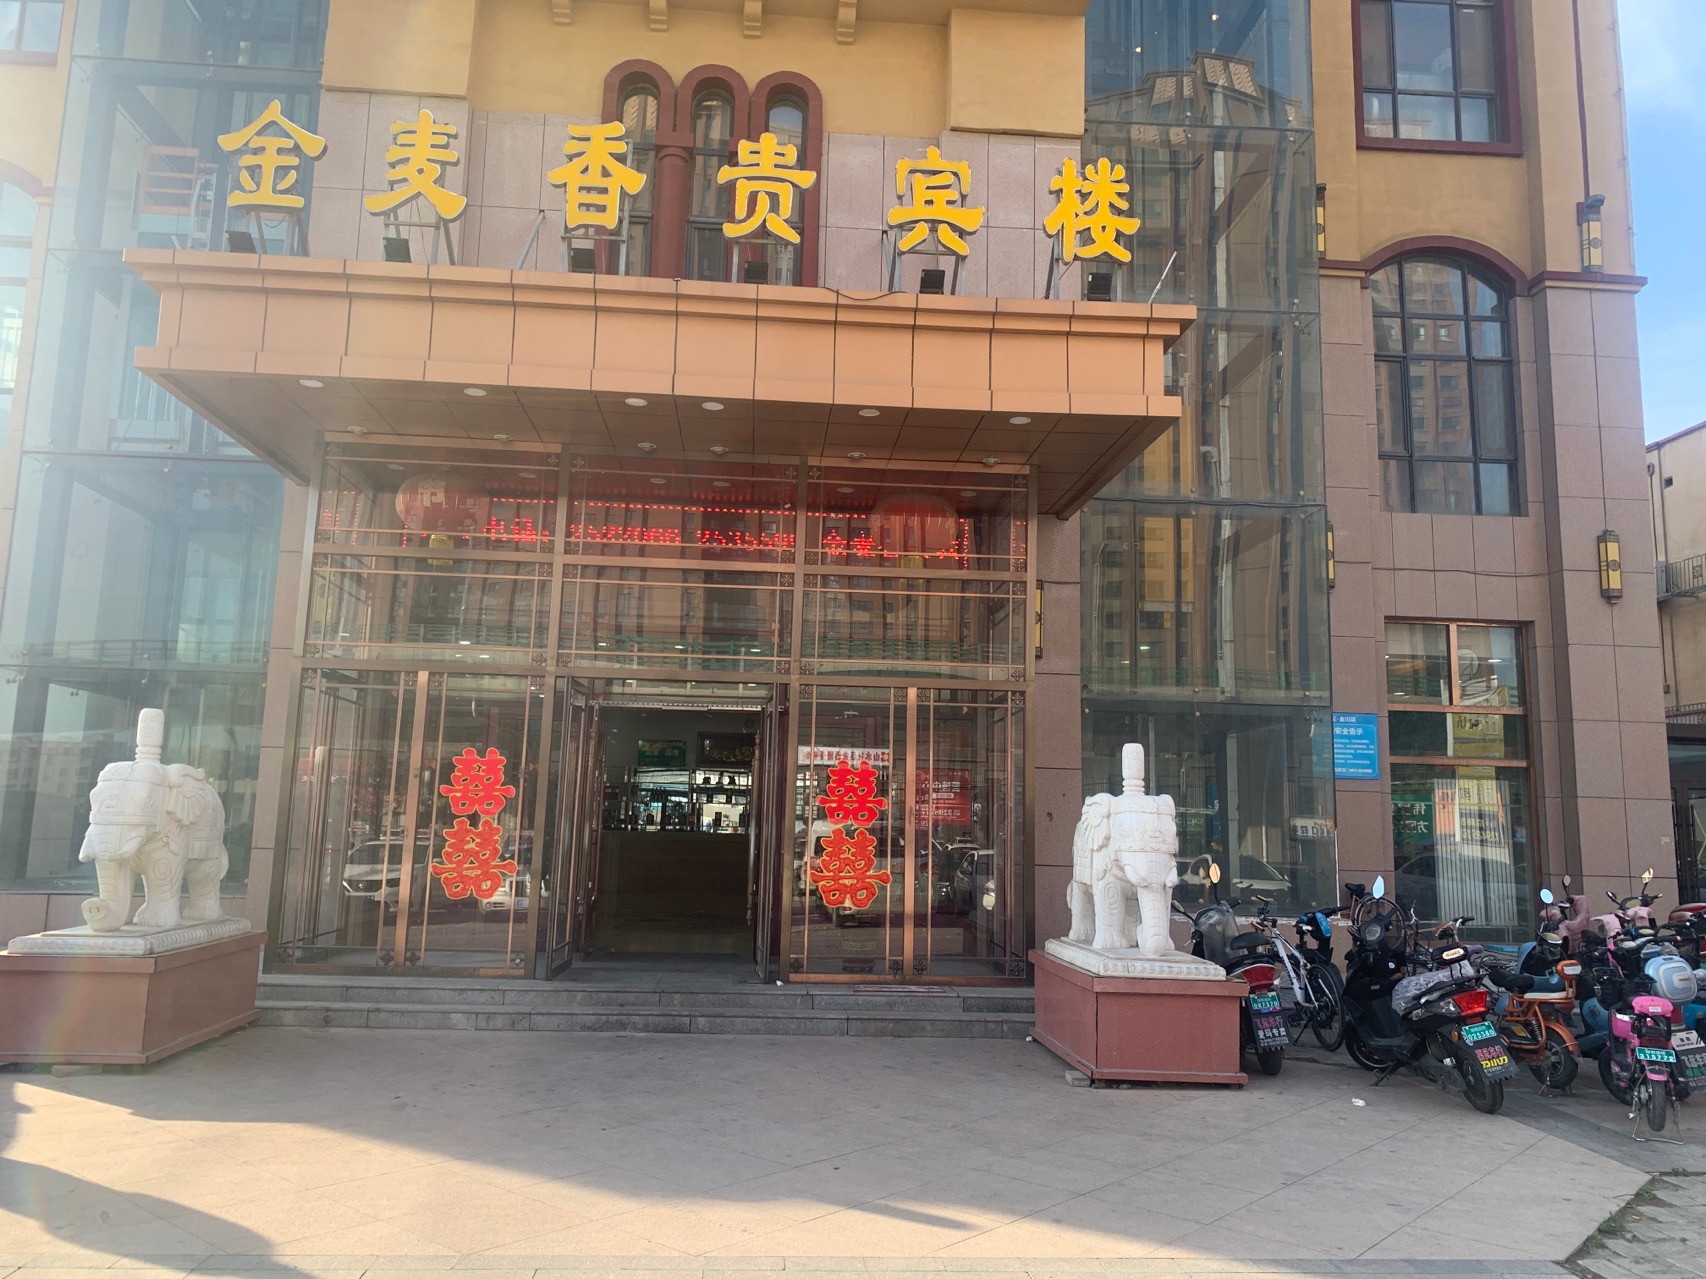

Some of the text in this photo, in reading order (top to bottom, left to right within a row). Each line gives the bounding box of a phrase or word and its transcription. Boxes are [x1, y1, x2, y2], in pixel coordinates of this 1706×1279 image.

[217, 99, 1141, 264] 金麦香贵宾楼
[1467, 1029, 1495, 1041] 025380
[1639, 1053, 1674, 1062] 315772
